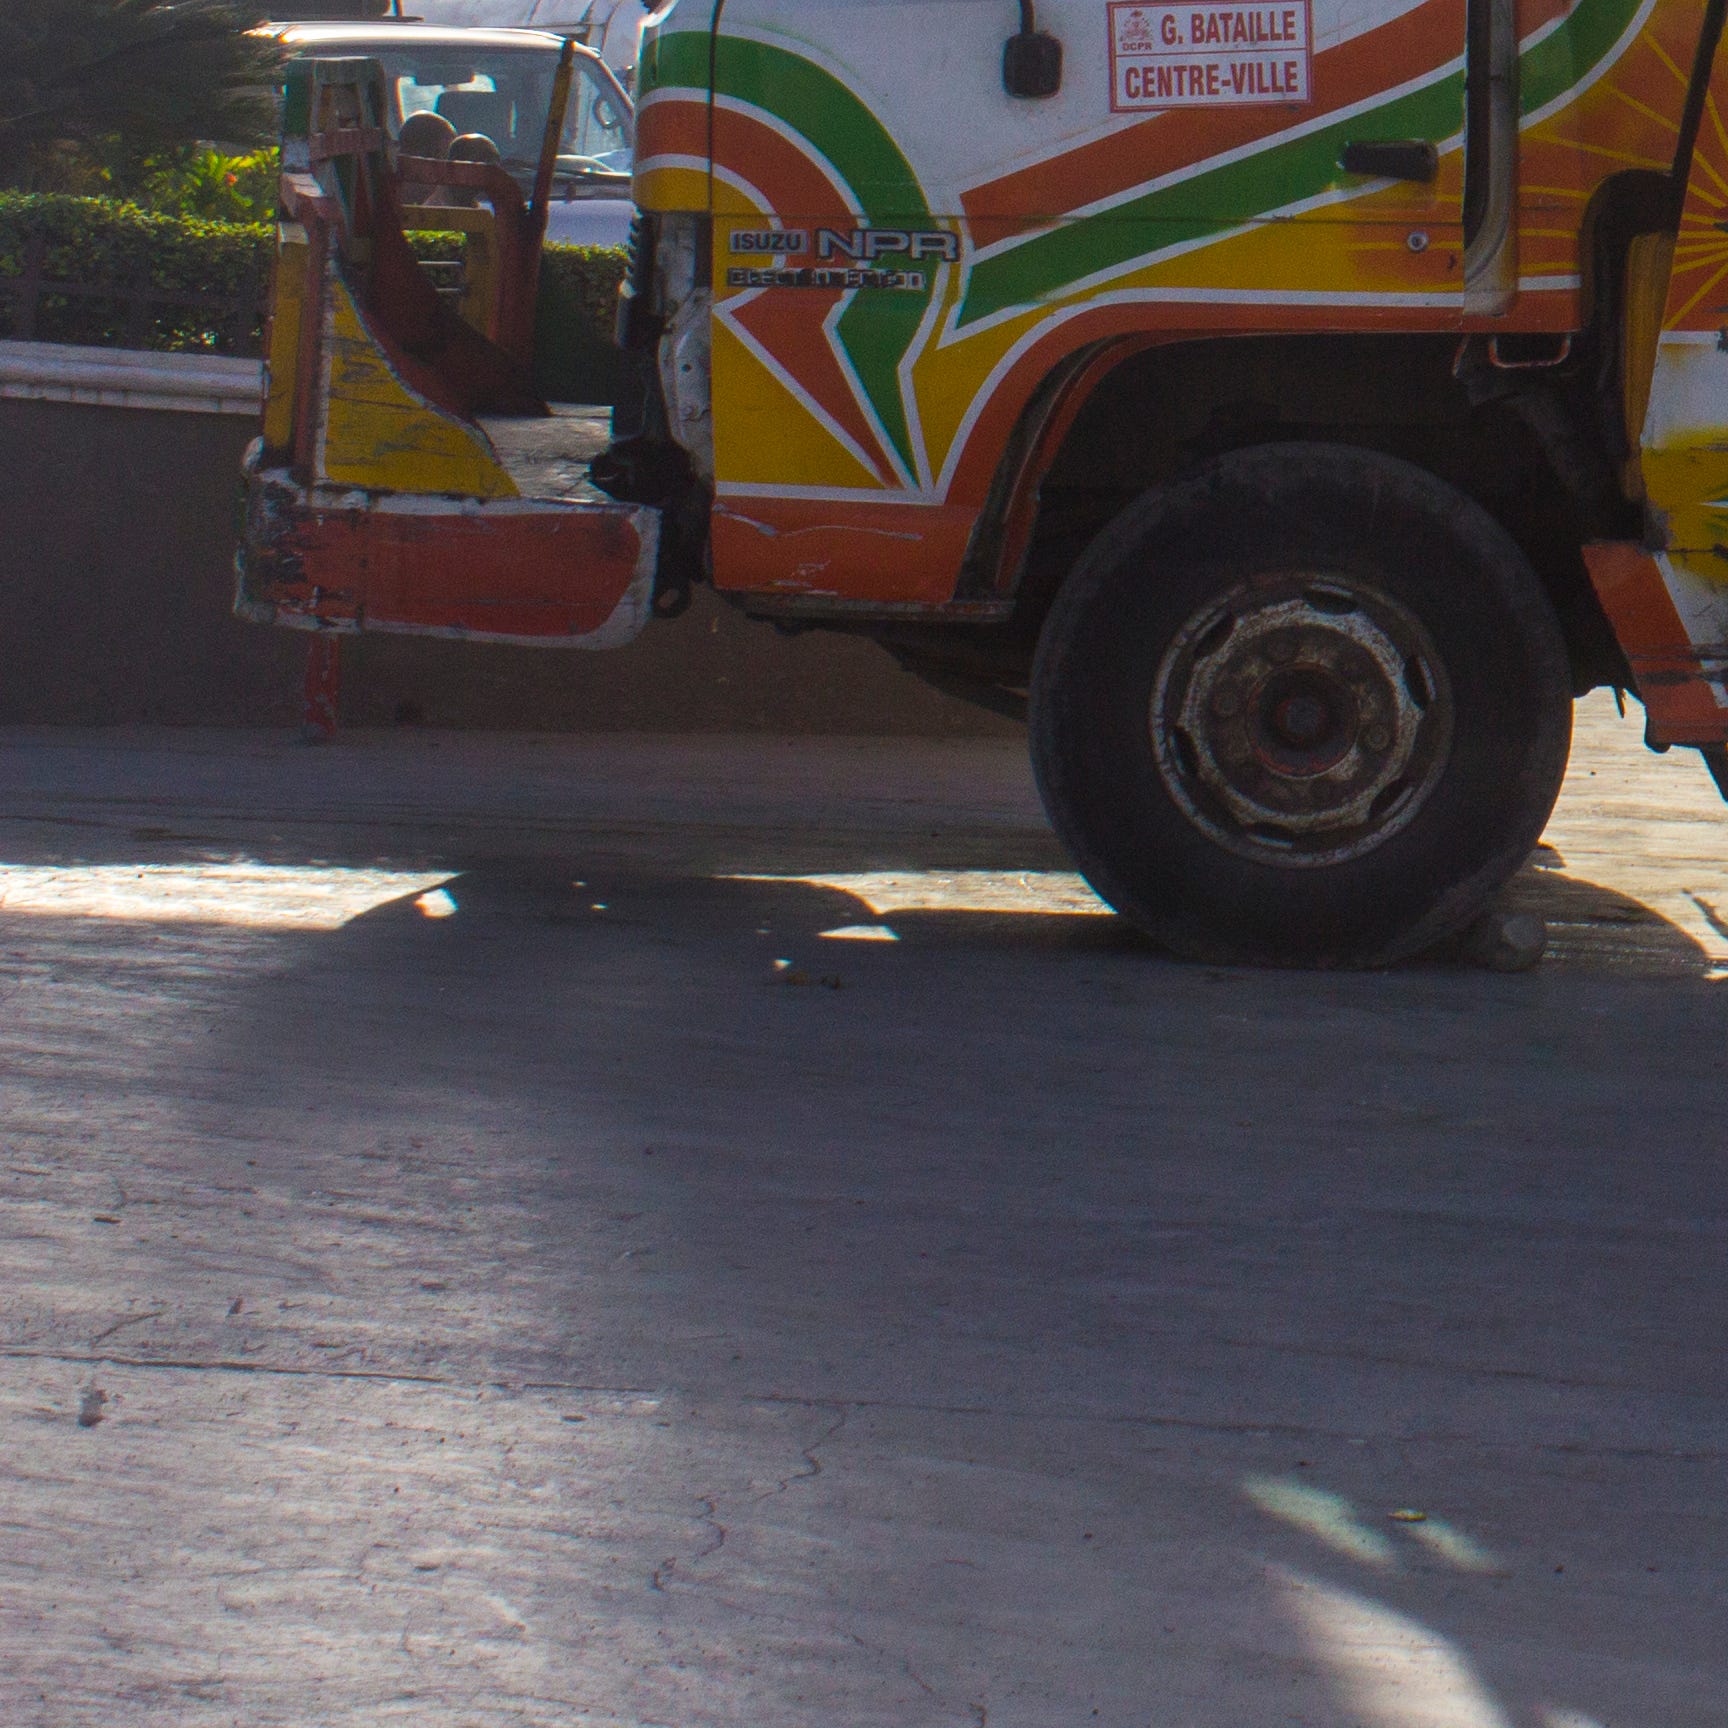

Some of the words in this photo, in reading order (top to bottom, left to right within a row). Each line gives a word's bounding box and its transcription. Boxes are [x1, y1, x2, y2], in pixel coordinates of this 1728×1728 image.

[1161, 13, 1184, 46] G.
[1190, 10, 1298, 45] BATAILLE
[1122, 41, 1153, 52] DCPR
[1125, 60, 1299, 99] CENTRE-VILLE
[733, 231, 802, 252] ISUZU
[815, 227, 961, 263] NPR
